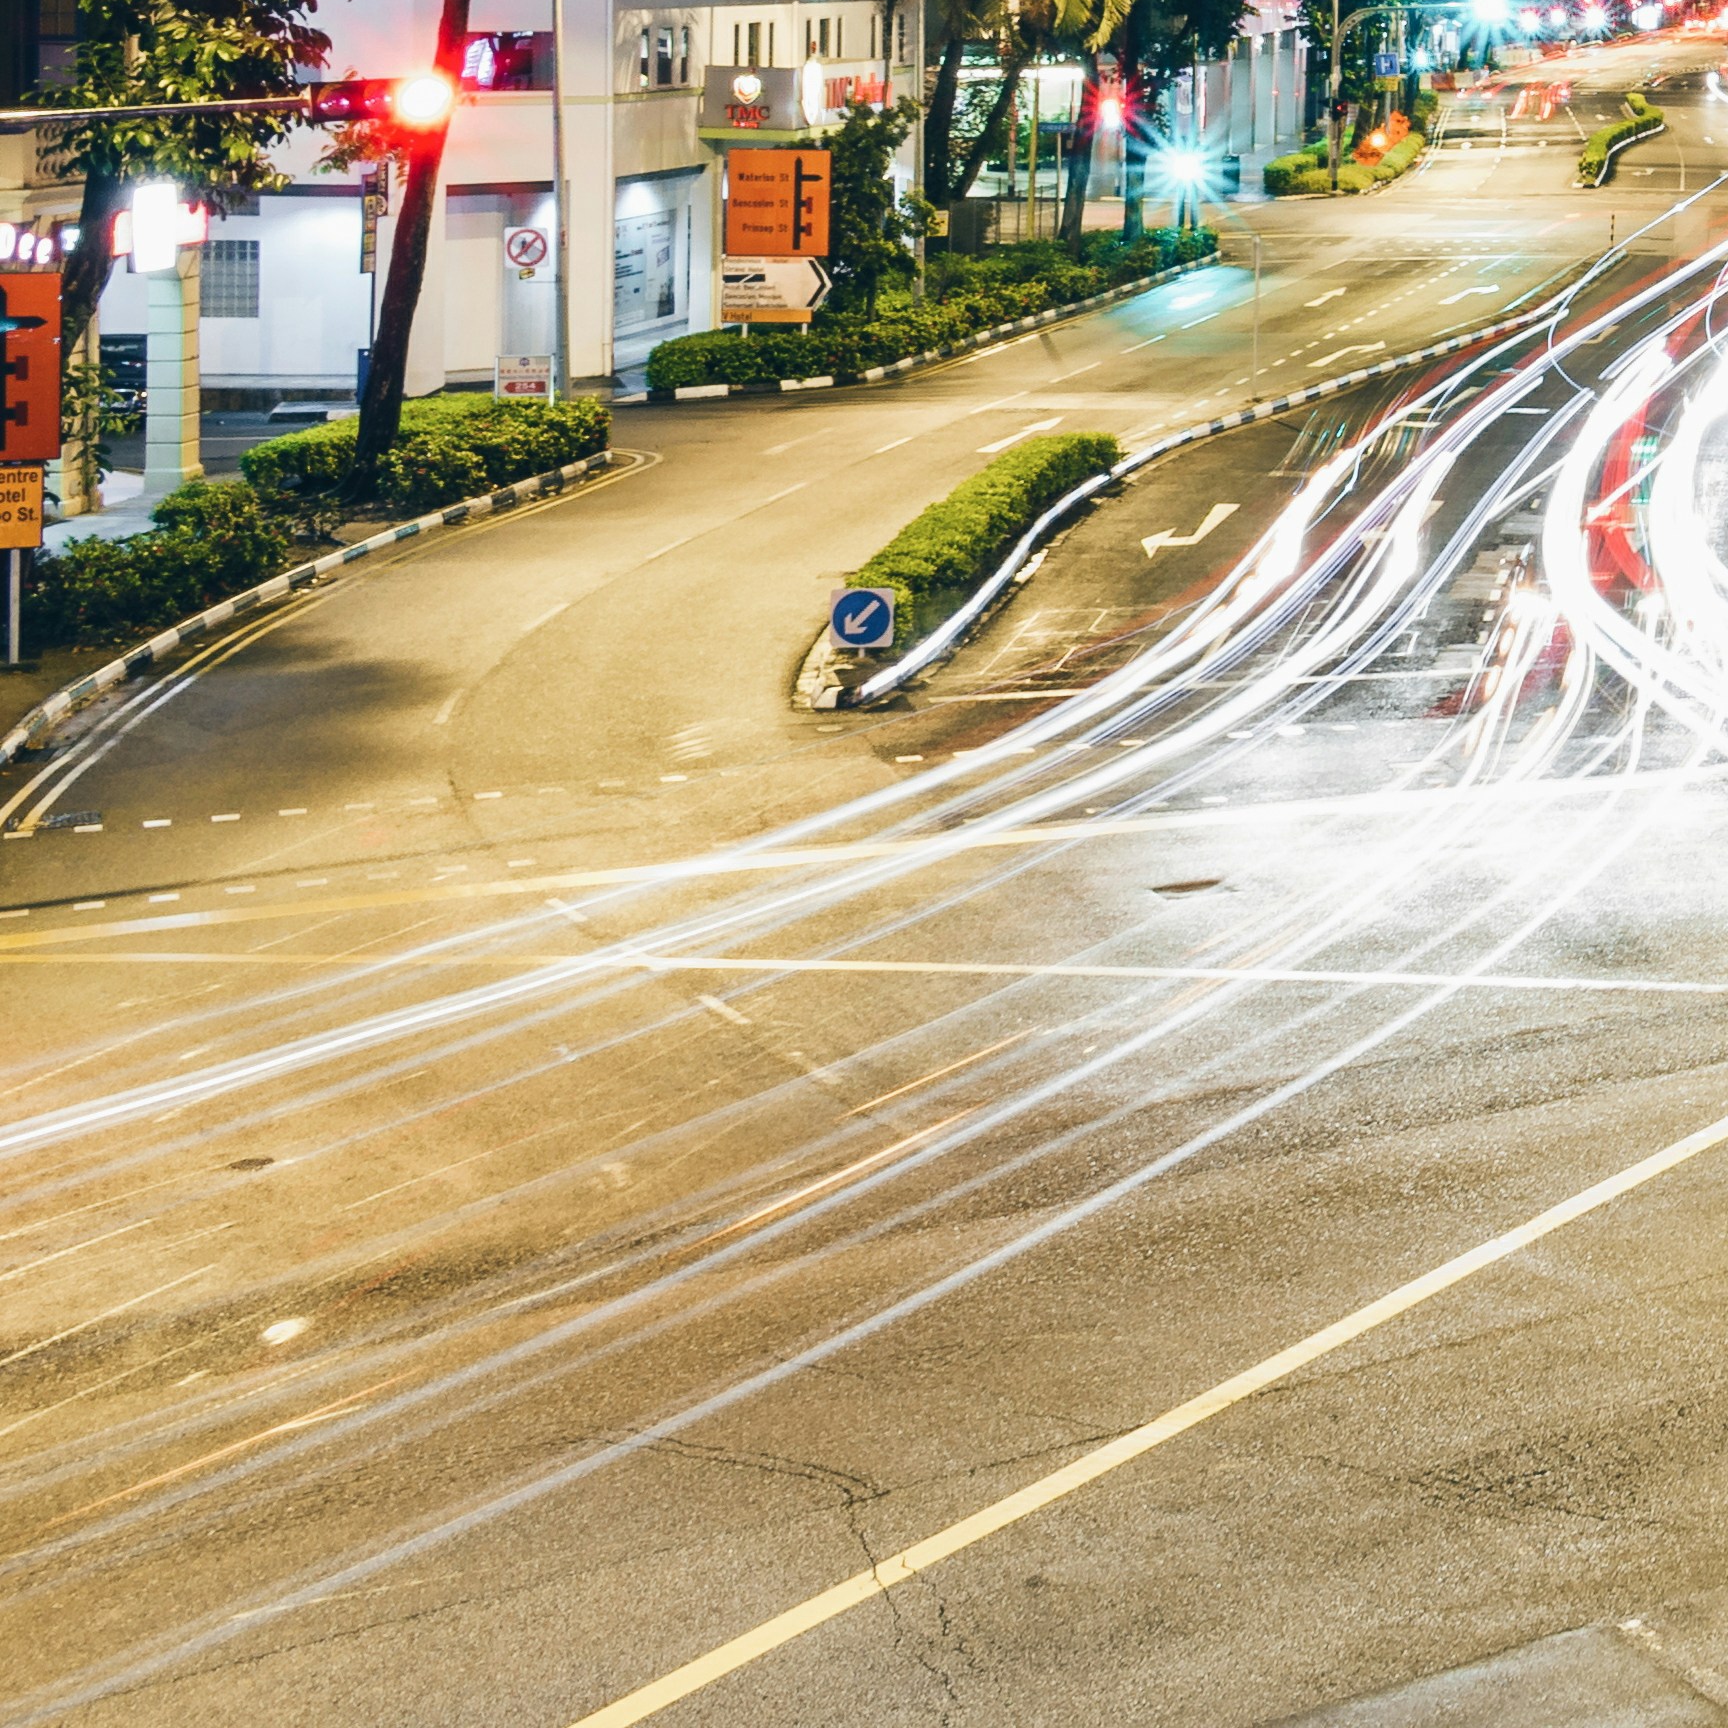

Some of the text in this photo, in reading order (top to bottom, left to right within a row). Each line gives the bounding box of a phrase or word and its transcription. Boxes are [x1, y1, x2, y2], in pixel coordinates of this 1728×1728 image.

[725, 105, 770, 120] TMC
[738, 172, 789, 182] Waterloo St
[732, 198, 788, 208] Bencoolen St
[778, 224, 788, 232] St
[730, 311, 753, 321] Hotel
[17, 506, 39, 521] St.
